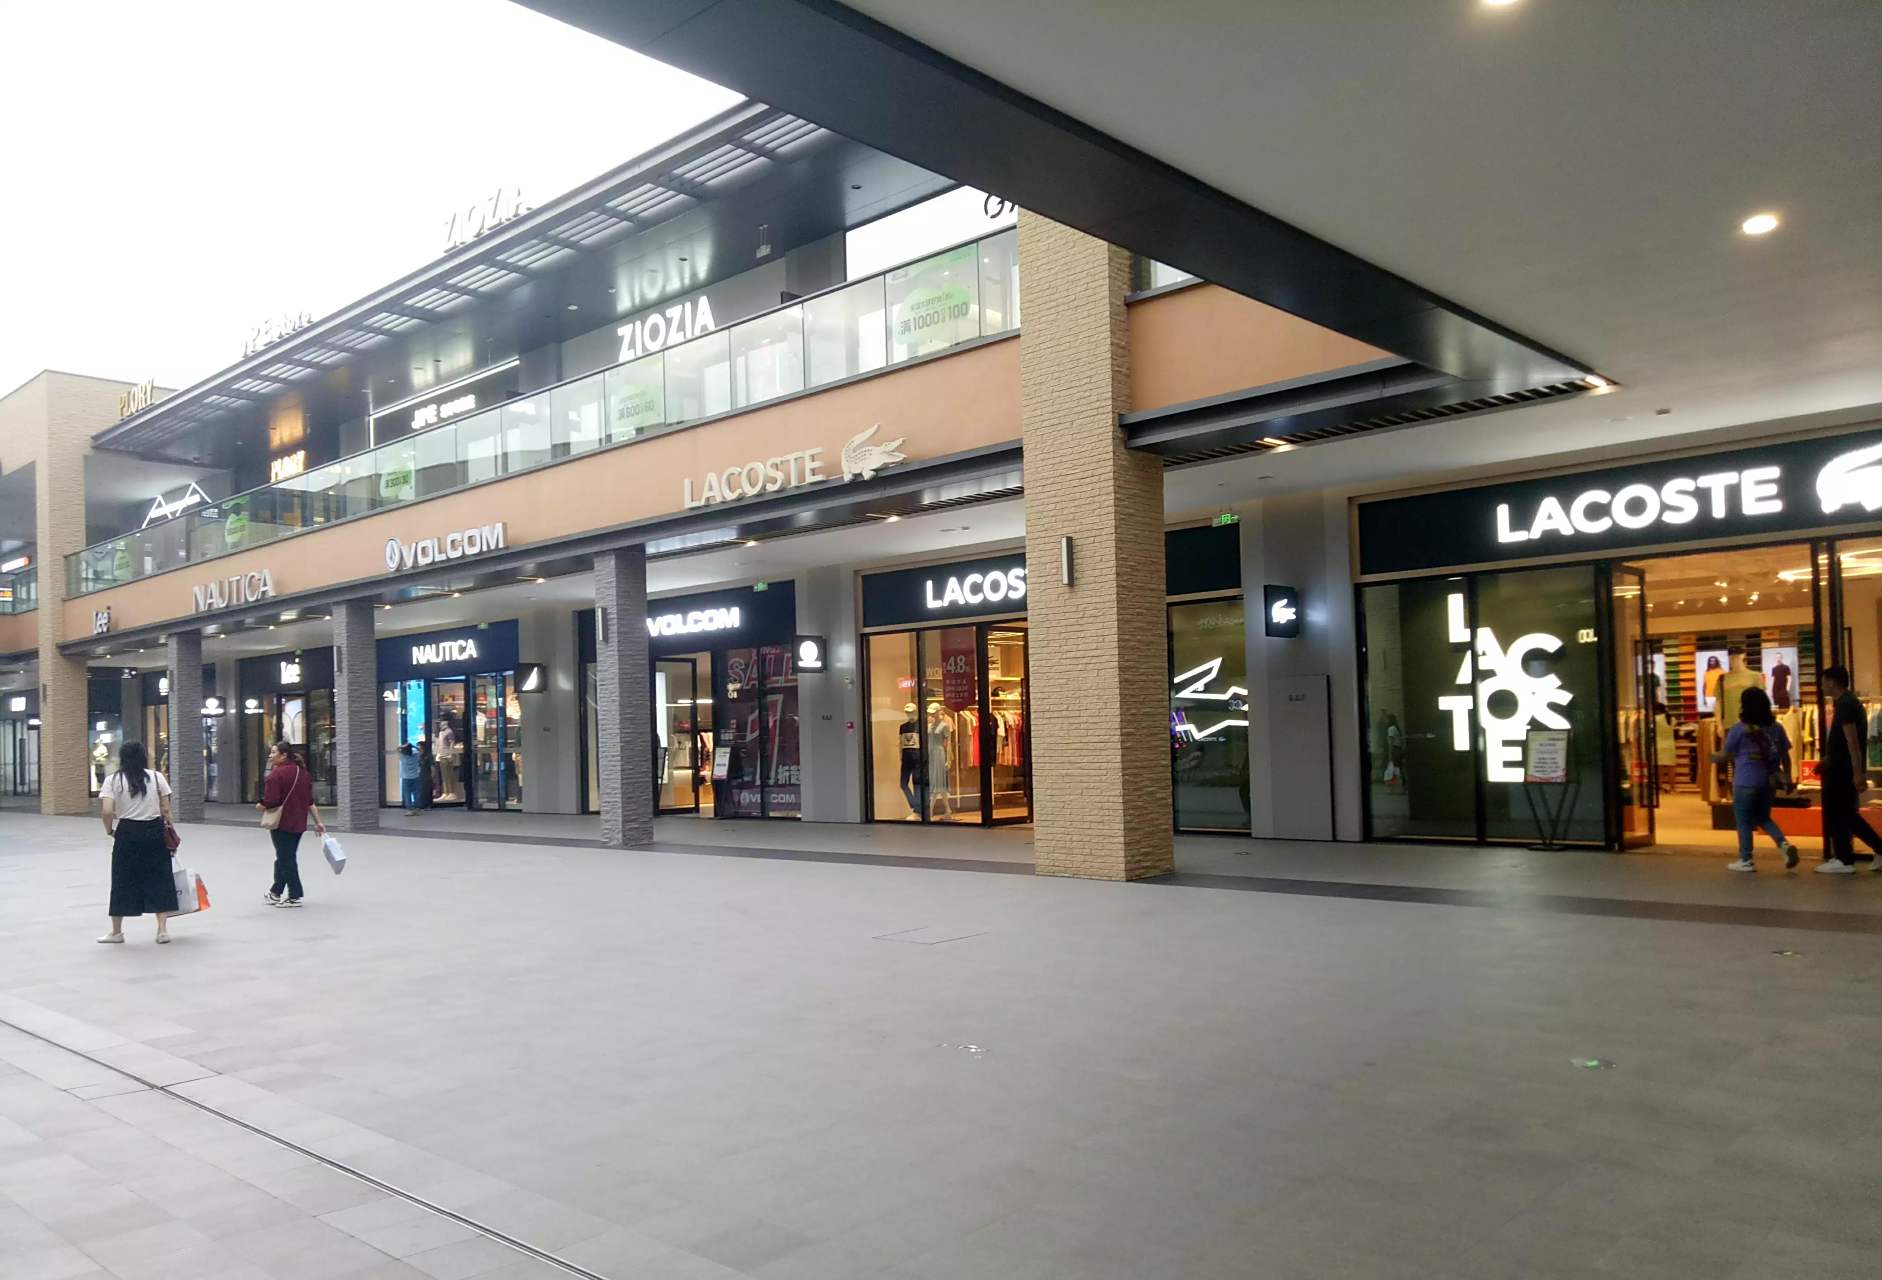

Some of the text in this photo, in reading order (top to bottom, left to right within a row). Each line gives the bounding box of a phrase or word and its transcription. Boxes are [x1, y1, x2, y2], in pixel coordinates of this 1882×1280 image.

[617, 295, 715, 363] ZIOZIA
[683, 448, 828, 508] LACOSTE
[1496, 466, 1784, 542] LACOSTE
[401, 522, 507, 569] VOLCOM
[192, 568, 275, 613] NAUTICA
[925, 568, 1025, 608] LACOS
[646, 607, 740, 637] VOLCOM
[412, 639, 477, 665] NAUTICA
